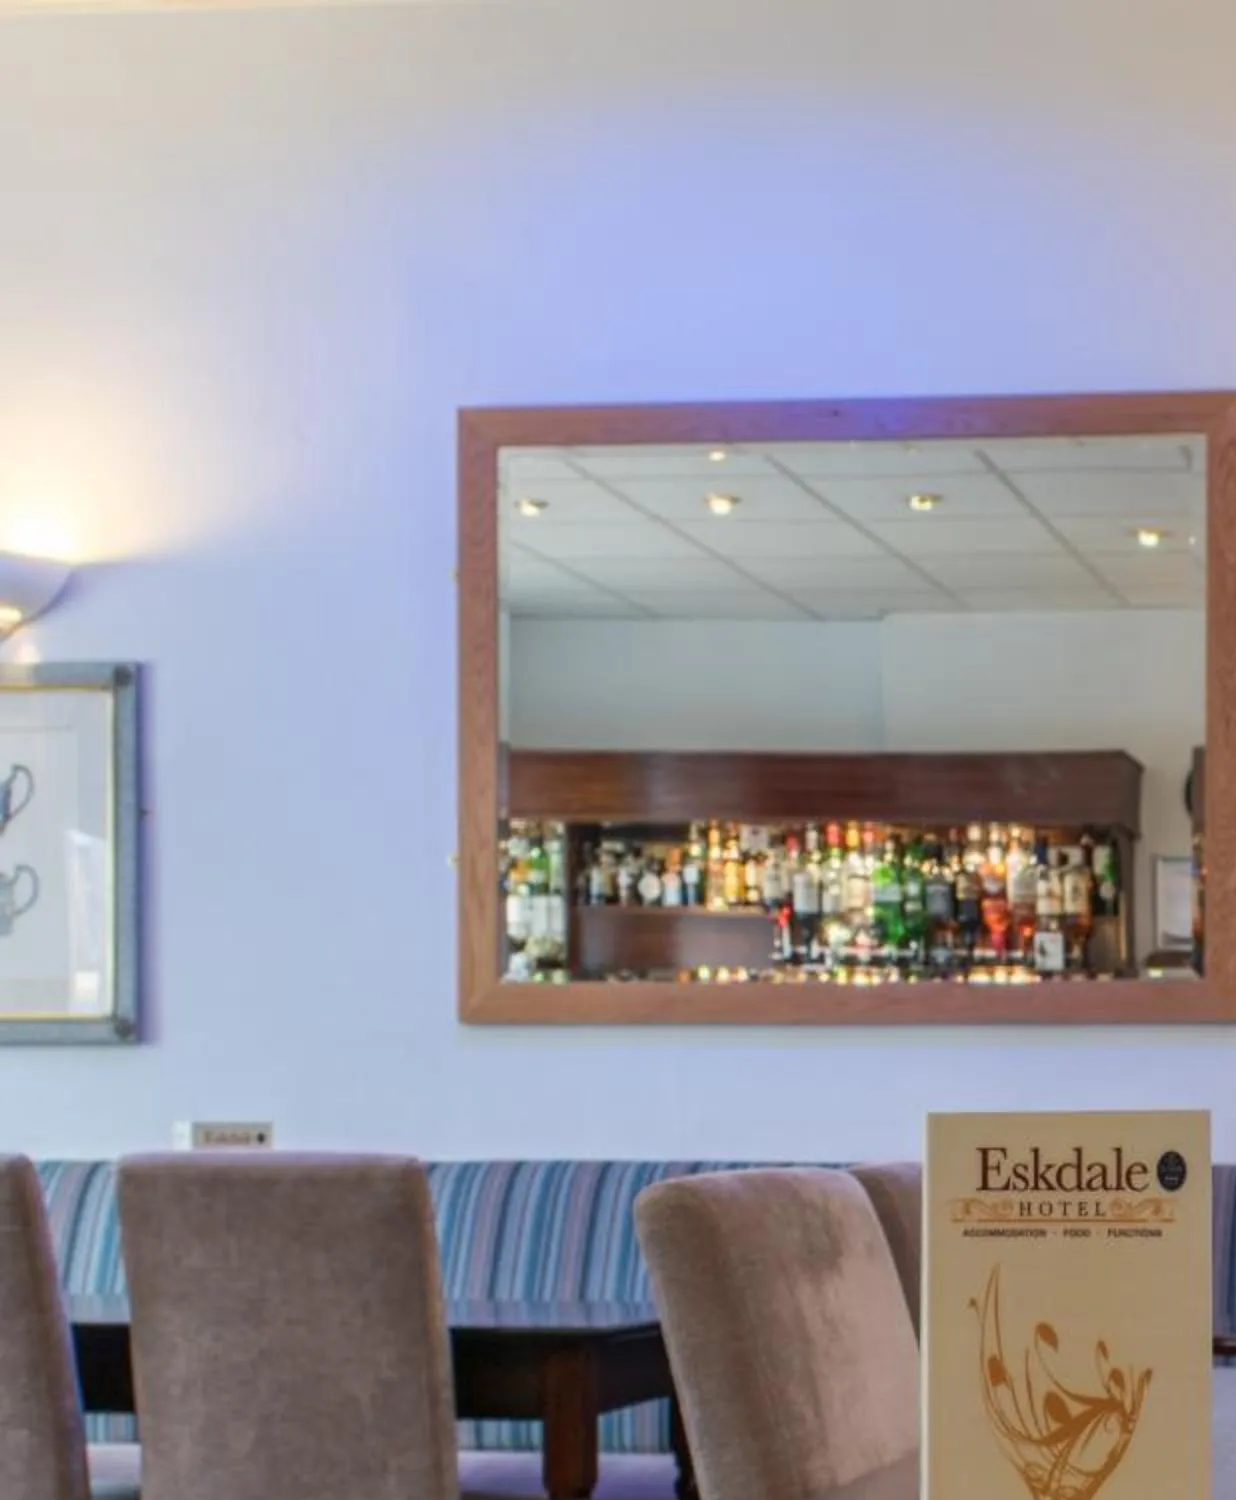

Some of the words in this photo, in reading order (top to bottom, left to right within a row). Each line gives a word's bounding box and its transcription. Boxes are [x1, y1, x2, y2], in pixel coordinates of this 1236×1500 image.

[976, 1146, 1150, 1193] Eskdale
[1018, 1200, 1107, 1217] HOTEL
[962, 1228, 1047, 1238] ACCOMMODATION
[1062, 1228, 1092, 1238] FOOD
[1106, 1227, 1164, 1238] FUNCTIONS
